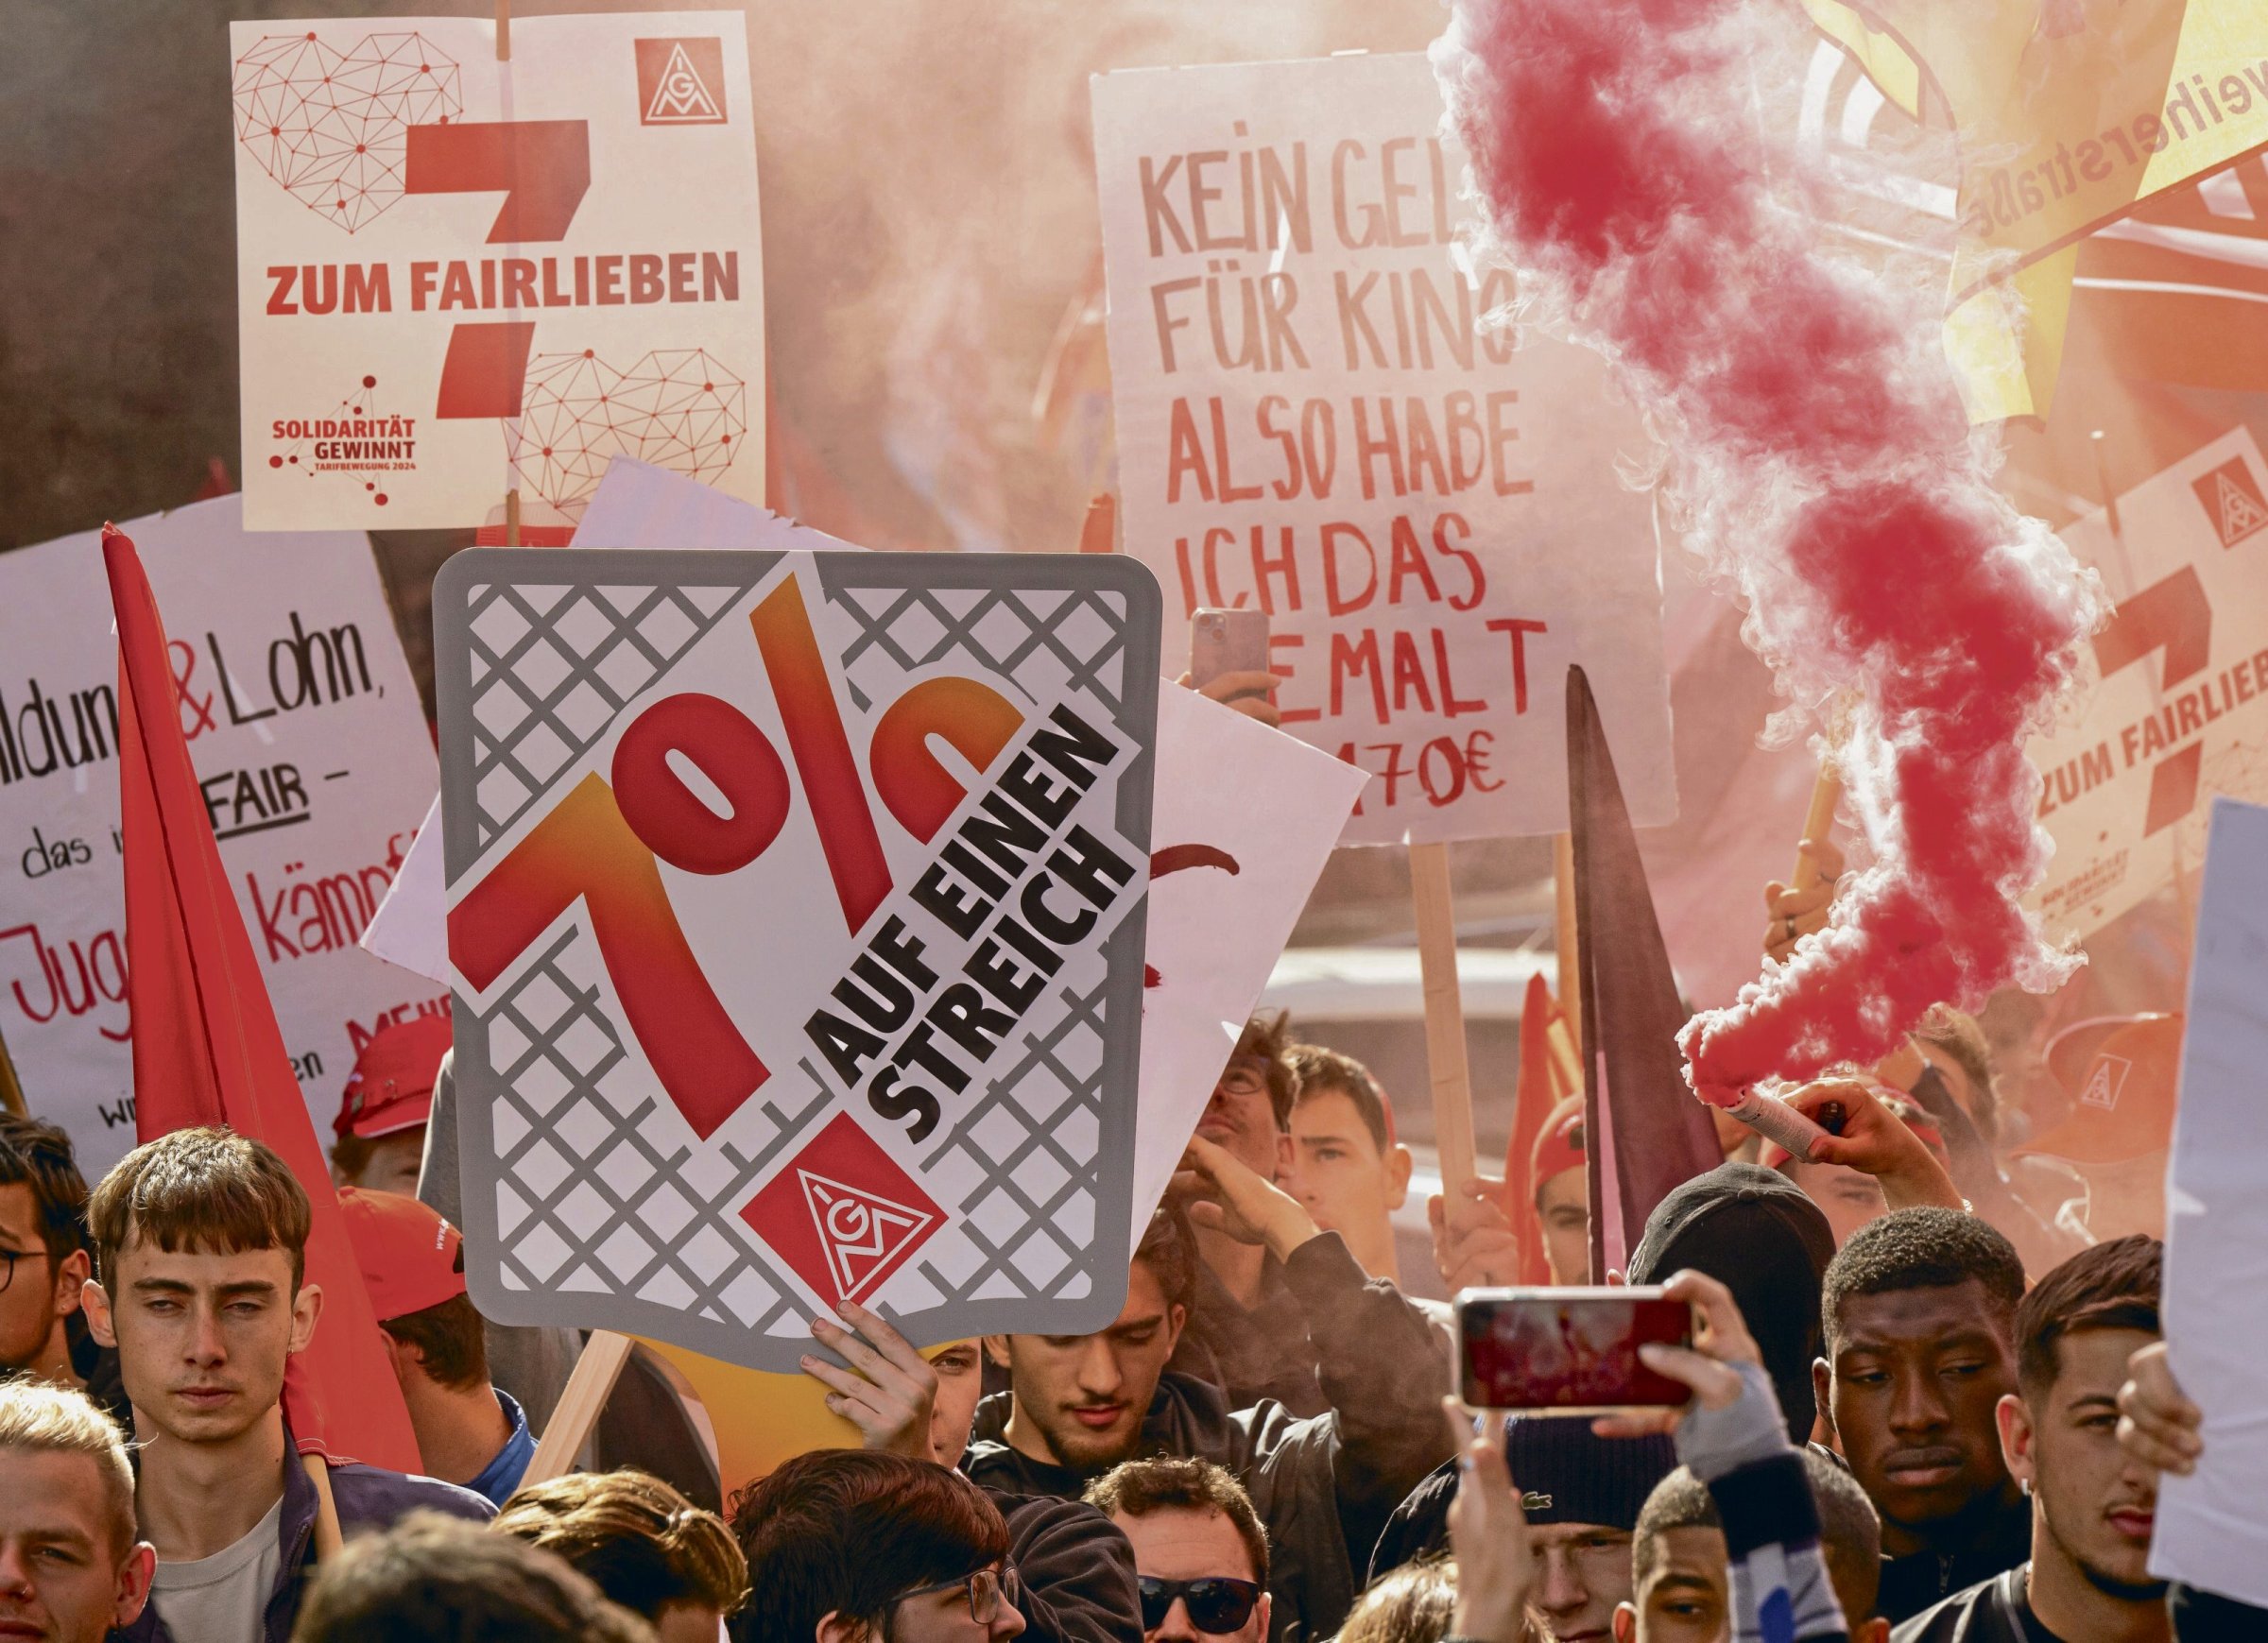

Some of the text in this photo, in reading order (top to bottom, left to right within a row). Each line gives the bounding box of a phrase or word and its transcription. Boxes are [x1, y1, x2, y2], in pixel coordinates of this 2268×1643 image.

[1332, 136, 1467, 251] GEL
[266, 251, 740, 316] ZUM FAIRLIEBEN
[1150, 258, 1518, 373] FÜR KINO
[272, 414, 416, 439] SOLIDARITÄT
[315, 441, 416, 459] GEWINNT
[315, 462, 417, 471] TARIFBEWEGUNG 2024
[1166, 389, 1535, 505] ALSO HABE
[1176, 512, 1486, 621] ICH DAS
[206, 610, 384, 726] Lohn,
[1268, 619, 1547, 726] EMALT
[22, 827, 92, 879] das
[199, 763, 310, 830] FAIR
[2036, 742, 2115, 820] ZUM
[803, 702, 1120, 1090] AUF EINEN
[0, 923, 132, 1039] Jug
[868, 823, 1137, 1145] STREICH
